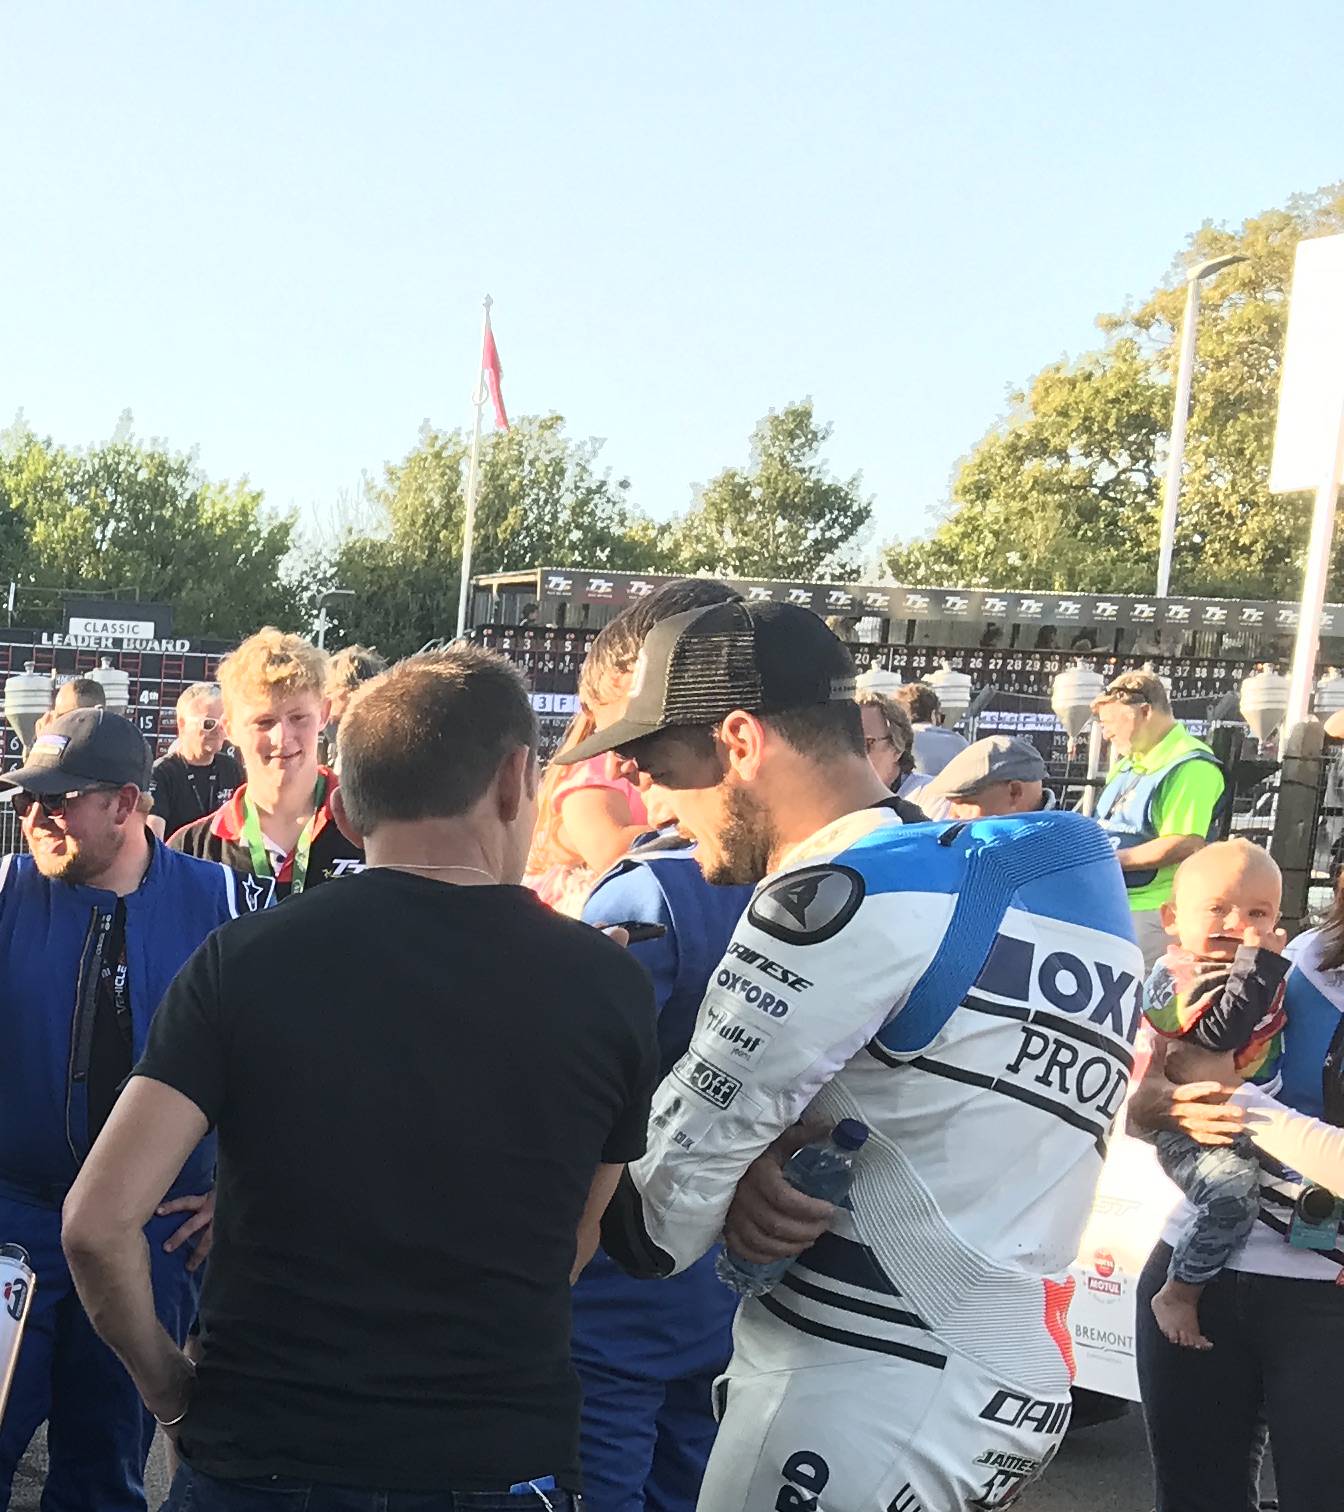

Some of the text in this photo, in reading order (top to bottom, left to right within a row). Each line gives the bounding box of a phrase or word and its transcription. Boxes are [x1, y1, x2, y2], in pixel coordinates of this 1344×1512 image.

[84, 621, 140, 635] CLASSIC
[41, 632, 191, 653] LEADER BOARD
[503, 638, 510, 649] 2
[523, 639, 531, 650] 3
[543, 640, 551, 650] 4
[564, 641, 572, 651] 5
[855, 653, 869, 665] 20
[894, 655, 907, 666] 22
[912, 656, 926, 667] 23
[969, 658, 983, 669] 26
[989, 658, 1002, 670] 27
[1006, 659, 1022, 671] 28
[1025, 660, 1041, 671] 29
[1044, 660, 1059, 672] 30
[140, 690, 159, 704] 4th
[560, 698, 567, 709] F
[140, 715, 154, 729] 15
[10, 736, 20, 750] 6
[727, 941, 814, 993] DAINESE
[114, 964, 128, 1014] VEHICLE
[716, 968, 789, 1019] OXFORD
[1088, 1277, 1122, 1294] MOTUL
[1075, 1324, 1133, 1349] BREMONT
[976, 1451, 1040, 1474] JAMES
